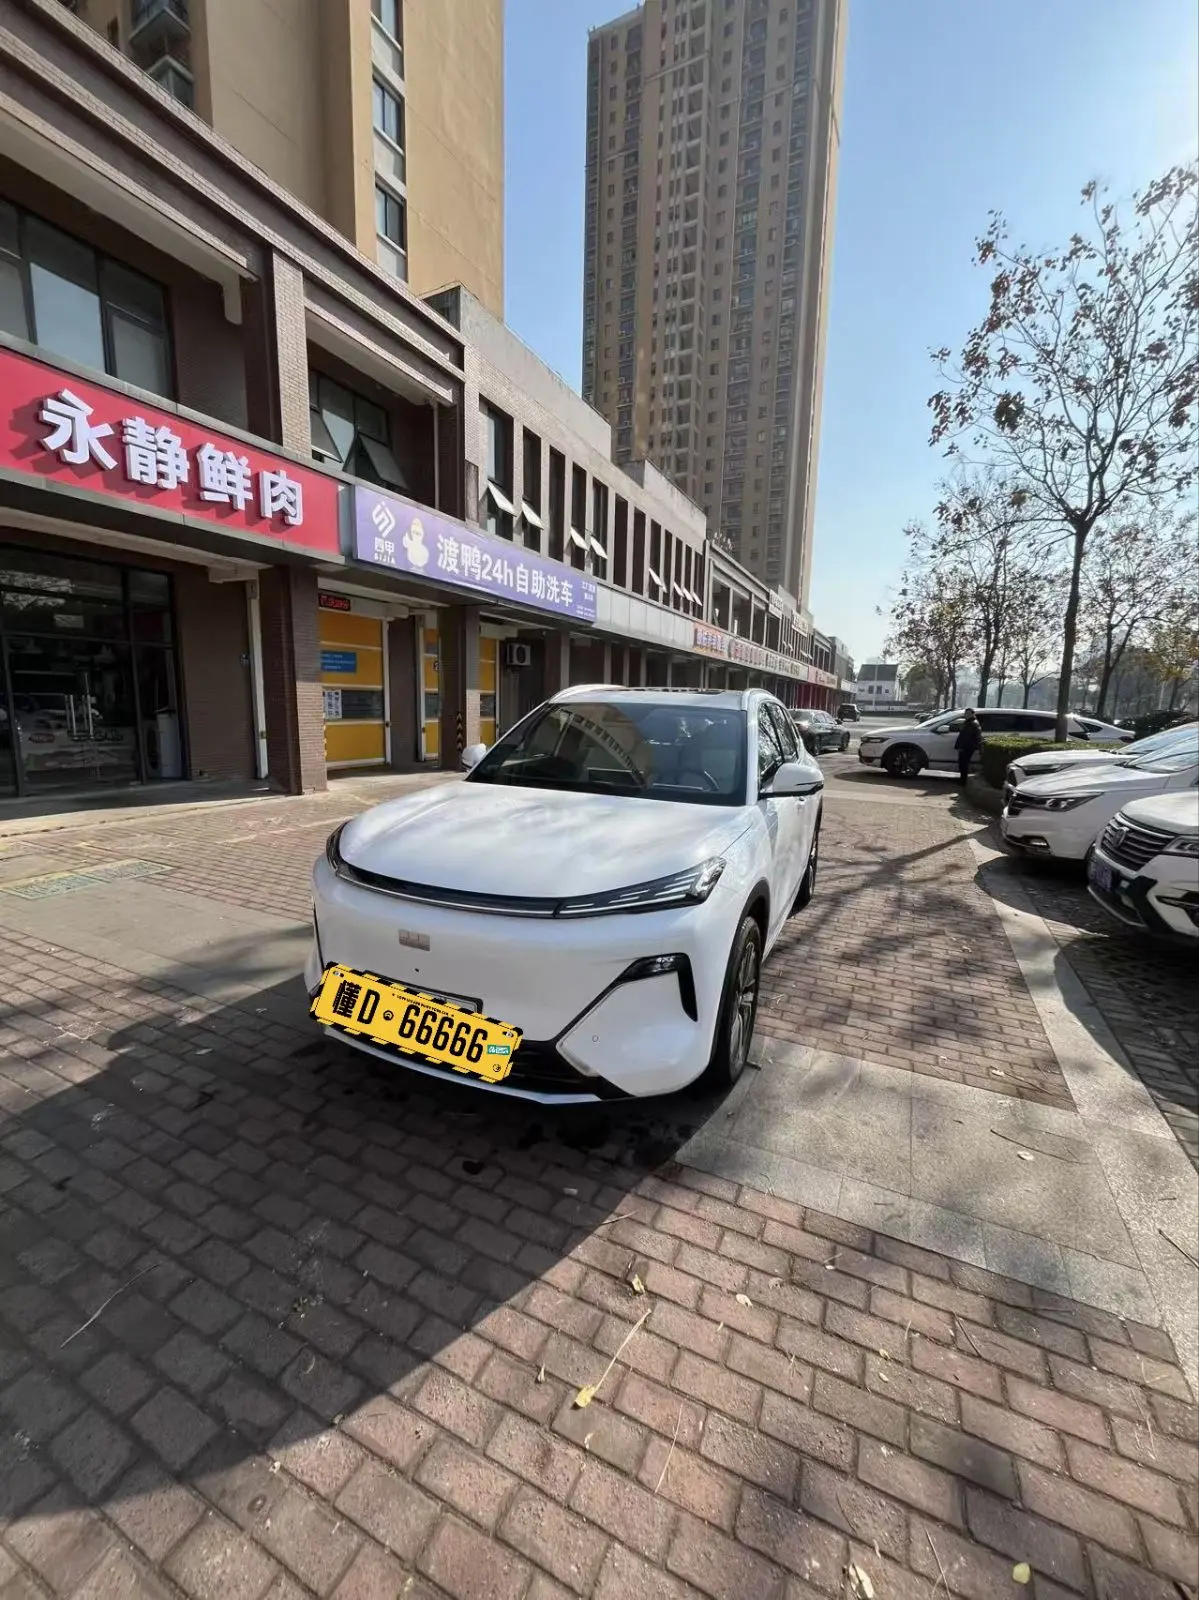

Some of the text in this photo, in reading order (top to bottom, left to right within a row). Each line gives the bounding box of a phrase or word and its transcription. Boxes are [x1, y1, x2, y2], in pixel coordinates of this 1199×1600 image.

[39, 388, 304, 526] 永静鲜肉
[436, 533, 574, 607] 渡鸭24h自助洗车
[398, 1004, 488, 1063] 66666
